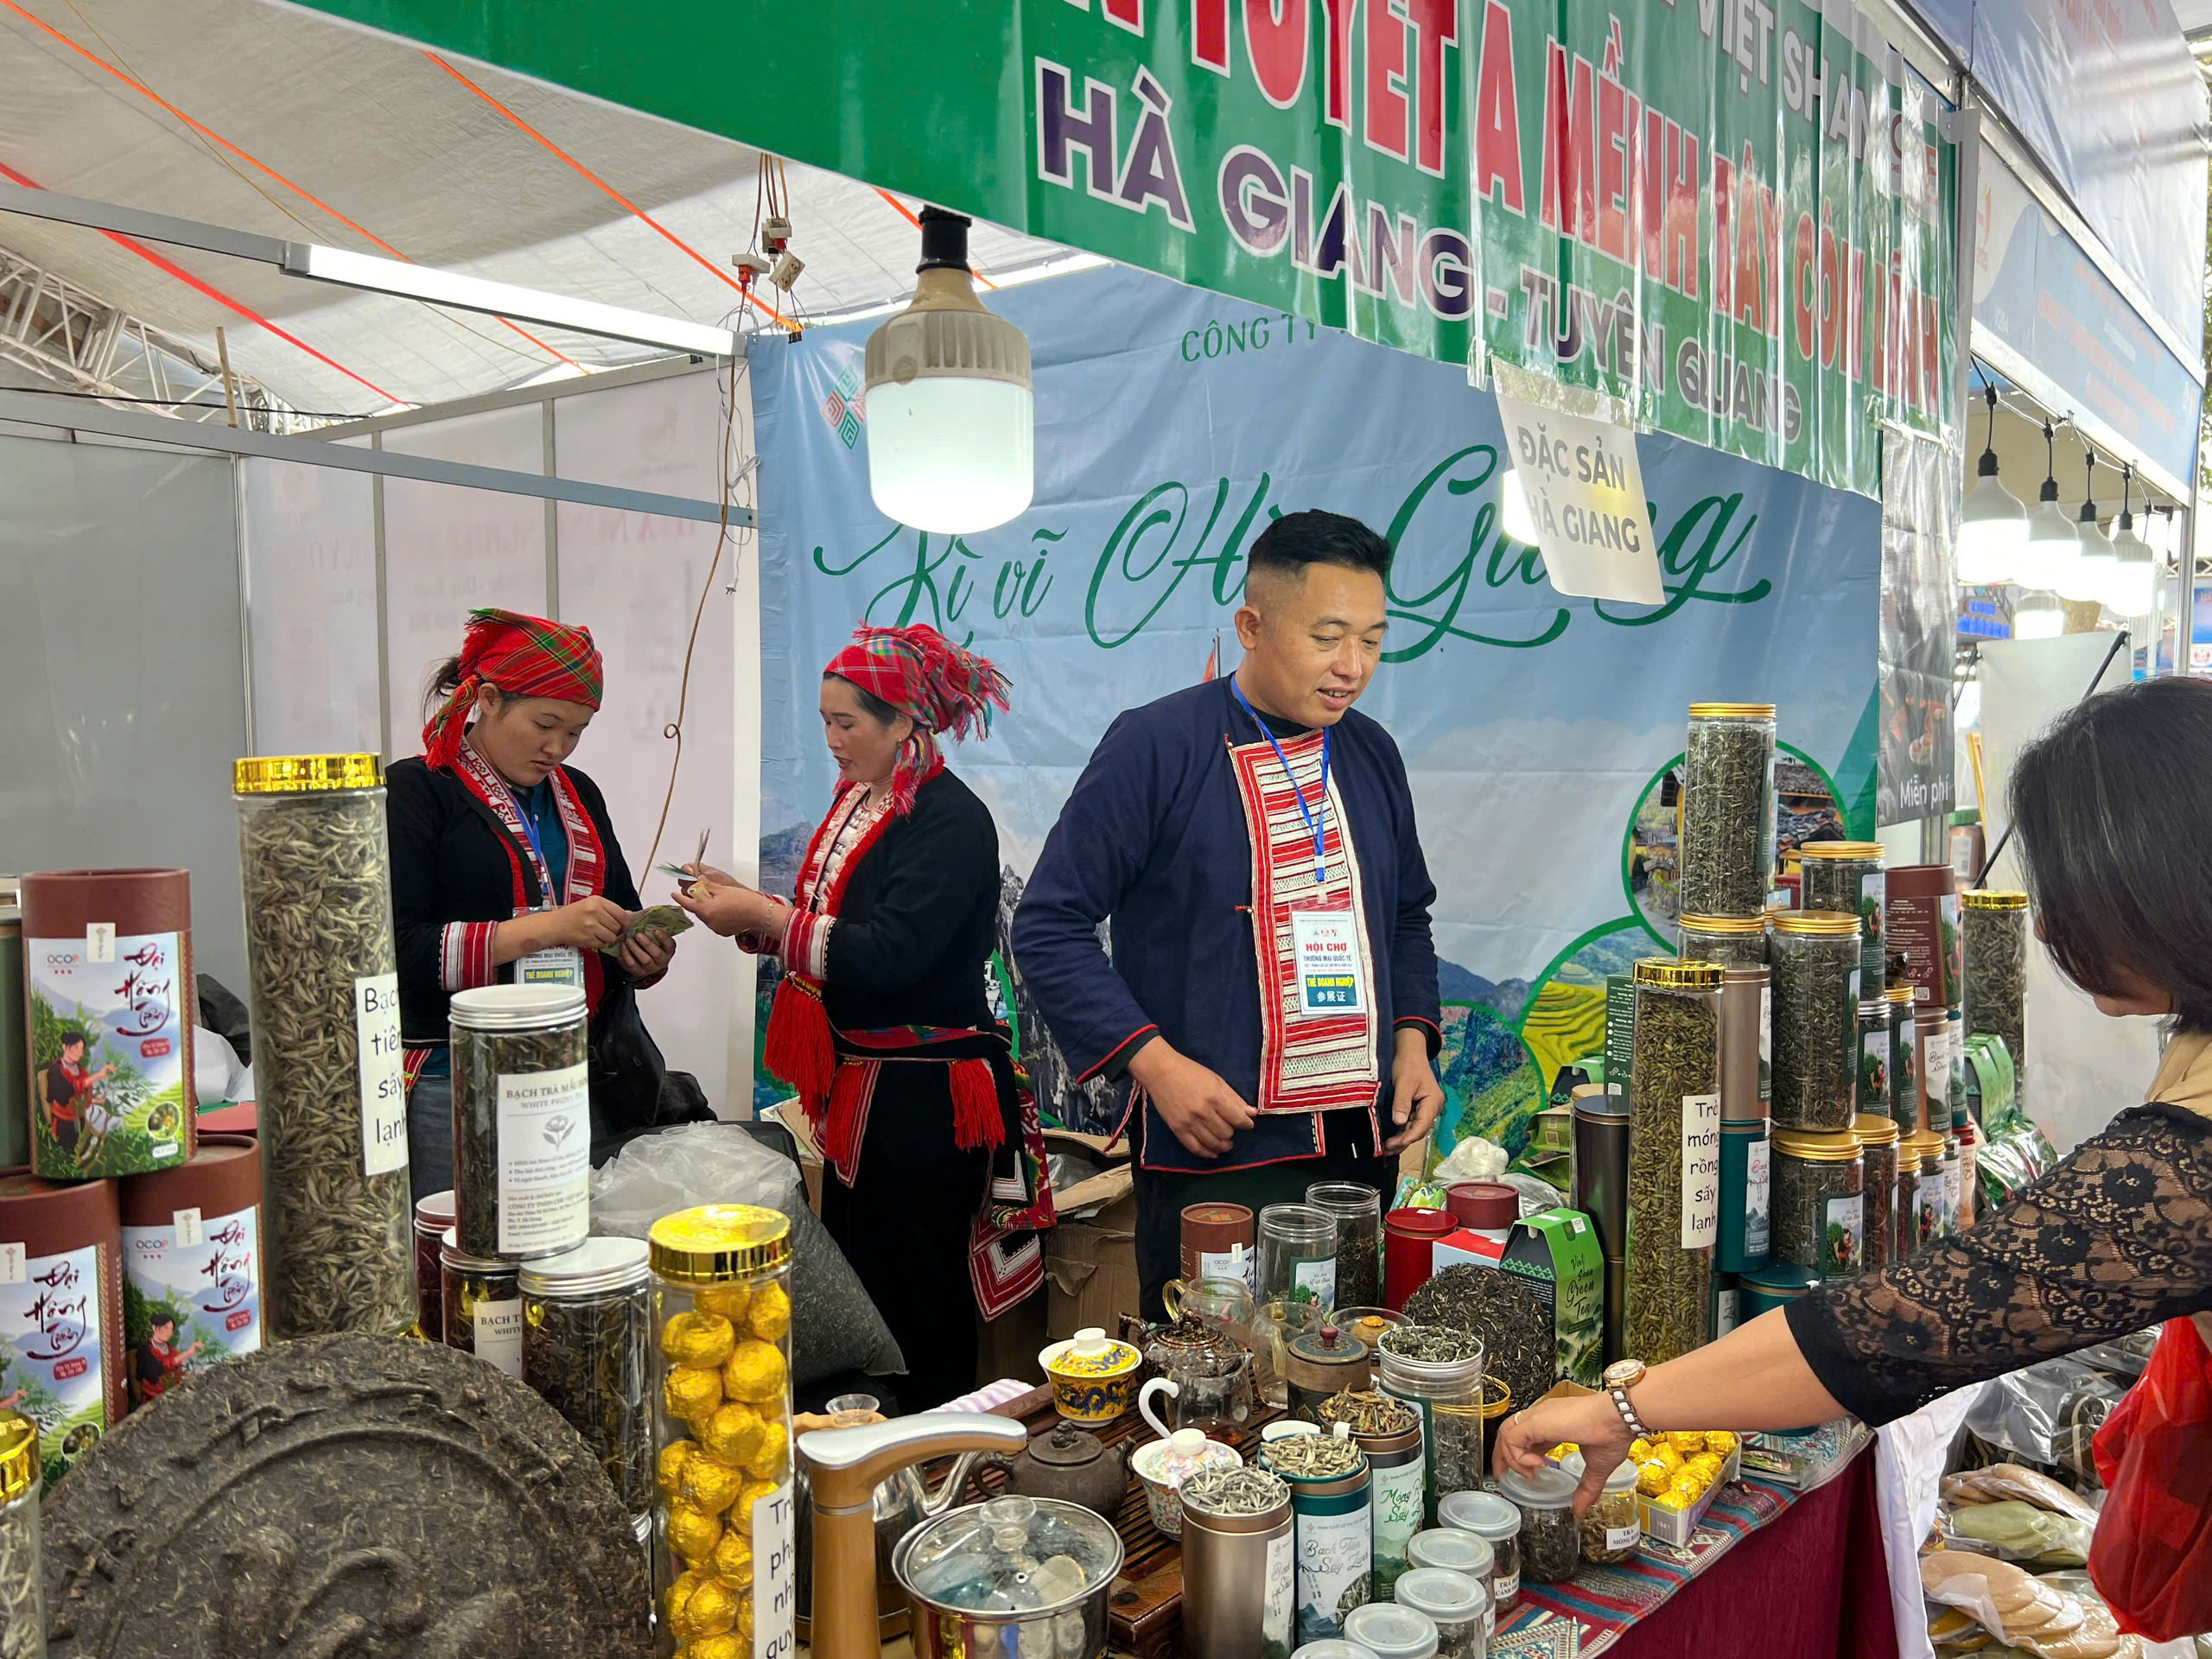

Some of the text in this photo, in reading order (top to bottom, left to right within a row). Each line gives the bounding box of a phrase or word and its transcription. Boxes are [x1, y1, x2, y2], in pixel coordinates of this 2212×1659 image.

[1474, 0, 1526, 218] A
[1036, 56, 1197, 233] HÀ
[1217, 144, 1476, 321] GIANG
[1519, 264, 1666, 396] TUYÊN
[1677, 336, 1802, 443] QUANG
[1182, 320, 1269, 362] CÔNG
[1517, 423, 1625, 491] ĐẶC SẢN
[1526, 487, 1640, 553] HÀ GIANG
[994, 526, 1070, 619] vĩ
[1900, 773, 1949, 810] Miễn phí
[1306, 942, 1347, 953] HỘI CHỢ
[48, 954, 79, 964] OCOP
[365, 987, 398, 1014] Bạc
[1317, 991, 1346, 1002] 参展证
[506, 1089, 537, 1099] BẠCH
[540, 1084, 558, 1096] TRÀ
[1695, 1099, 1718, 1118] Trà
[1690, 1157, 1718, 1175] rồng
[1695, 1184, 1715, 1205] sấy
[1692, 1211, 1715, 1233] lạnh
[136, 1239, 168, 1249] OCOP
[1566, 1280, 1594, 1308] Green
[1574, 1297, 1592, 1320] Tea
[481, 1316, 510, 1326] BẠCH
